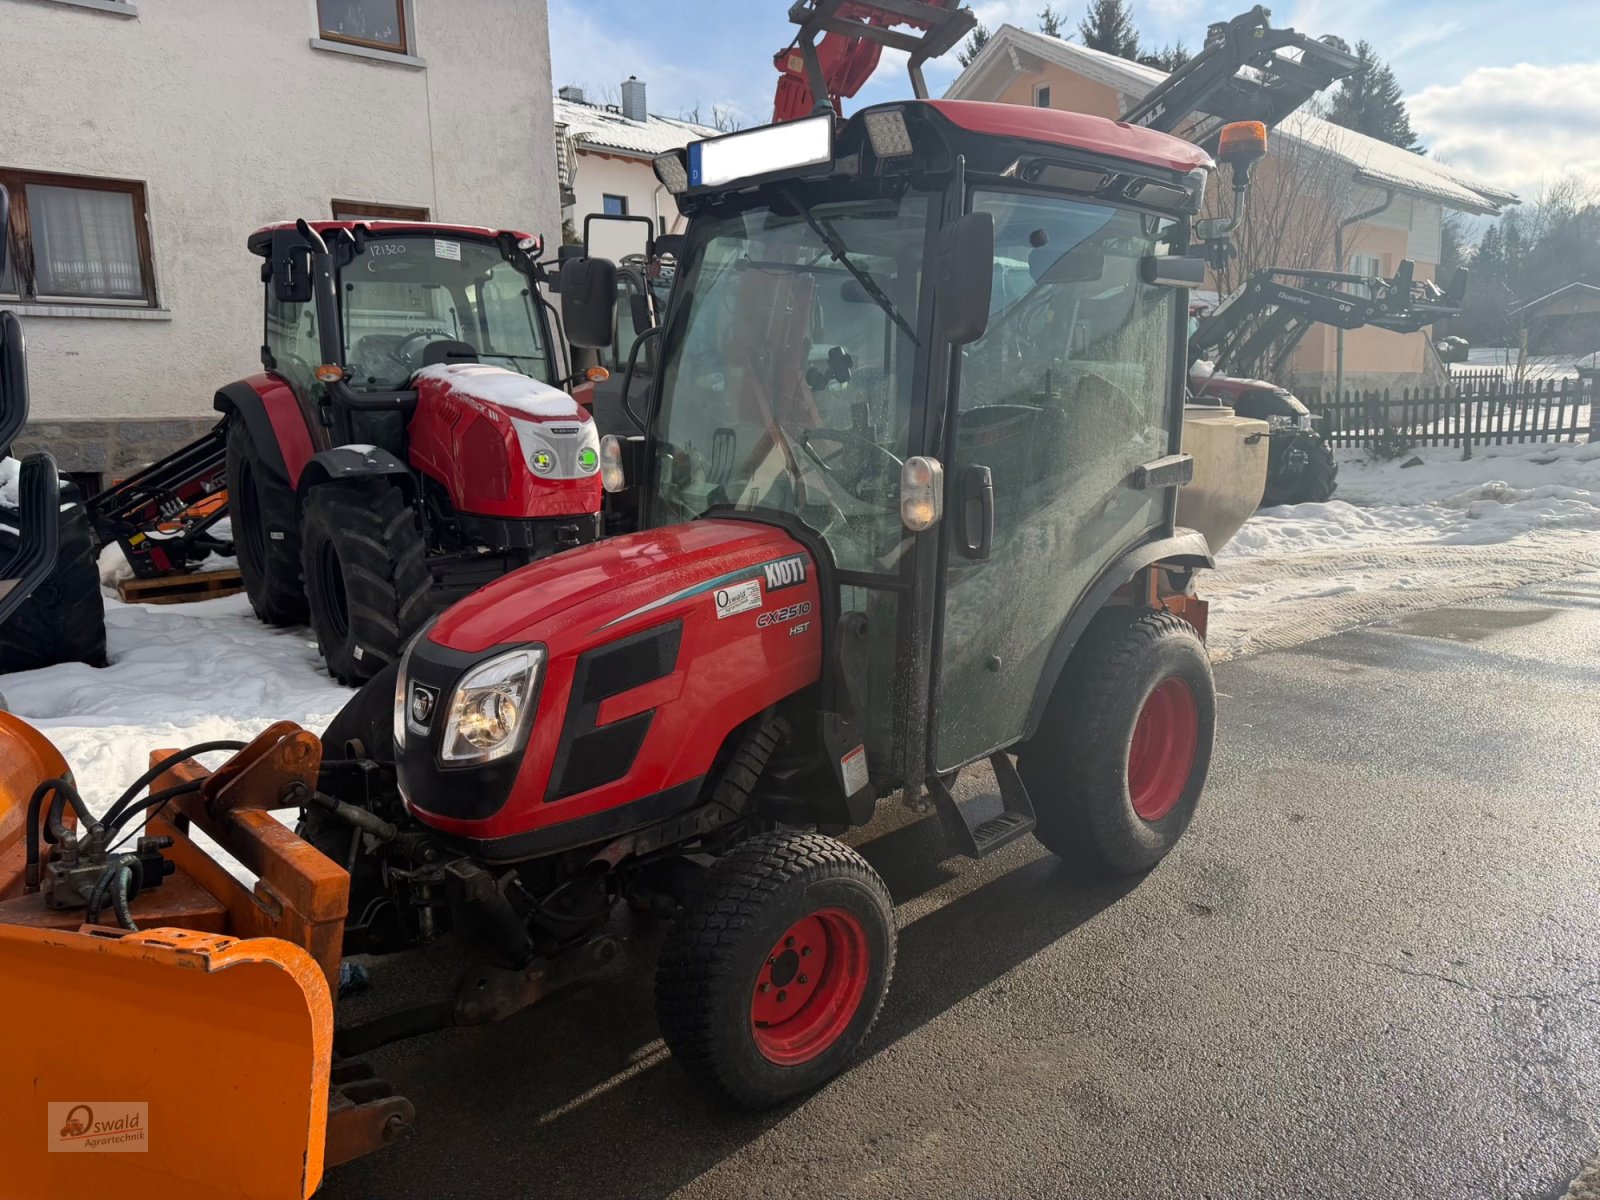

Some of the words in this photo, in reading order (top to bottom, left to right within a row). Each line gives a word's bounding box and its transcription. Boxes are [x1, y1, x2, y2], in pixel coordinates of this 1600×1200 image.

[1278, 291, 1311, 306] Quicke
[764, 557, 805, 589] KIOTI
[716, 589, 746, 608] Oswald
[756, 600, 812, 629] CX2510
[789, 621, 810, 636] HST
